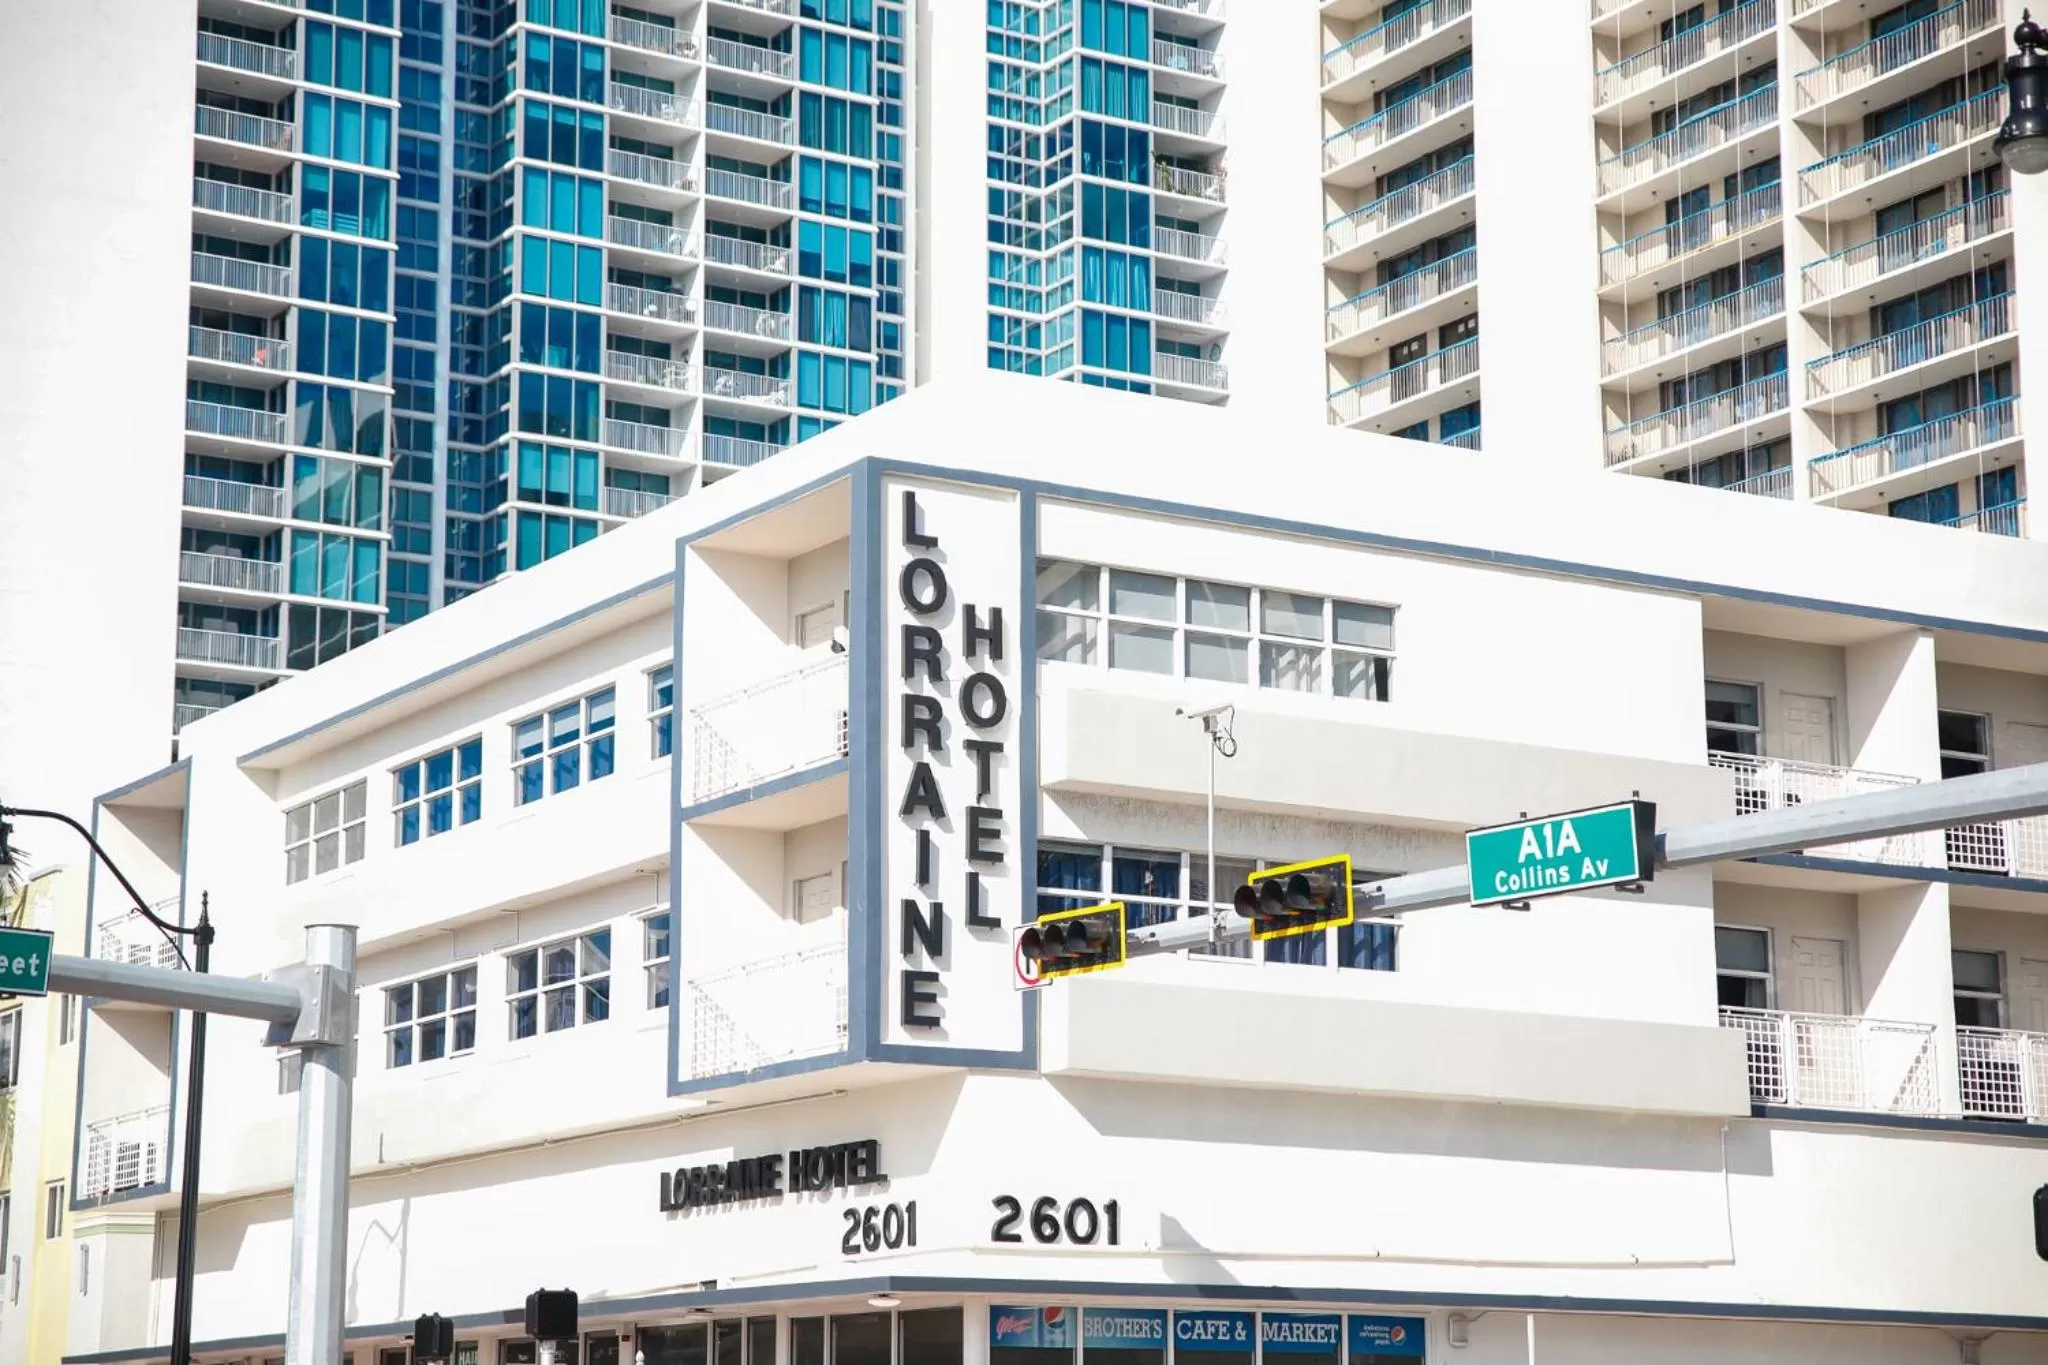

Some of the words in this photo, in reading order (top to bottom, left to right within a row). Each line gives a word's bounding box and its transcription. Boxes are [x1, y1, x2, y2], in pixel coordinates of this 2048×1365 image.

[900, 491, 947, 1029] LORRAINE
[958, 604, 1006, 929] HOTEL
[1518, 820, 1582, 863] A1A
[1495, 864, 1570, 893] Collins
[1581, 857, 1609, 880] Av
[660, 1154, 783, 1212] LORRAINE
[789, 1139, 888, 1193] HOTEL
[842, 1201, 917, 1255] 2601
[991, 1195, 1118, 1246] 2601
[1084, 1317, 1162, 1339] BROTHER'S
[1176, 1319, 1230, 1340] CAFE
[1235, 1320, 1247, 1341] &
[1262, 1321, 1340, 1344] MARKET
